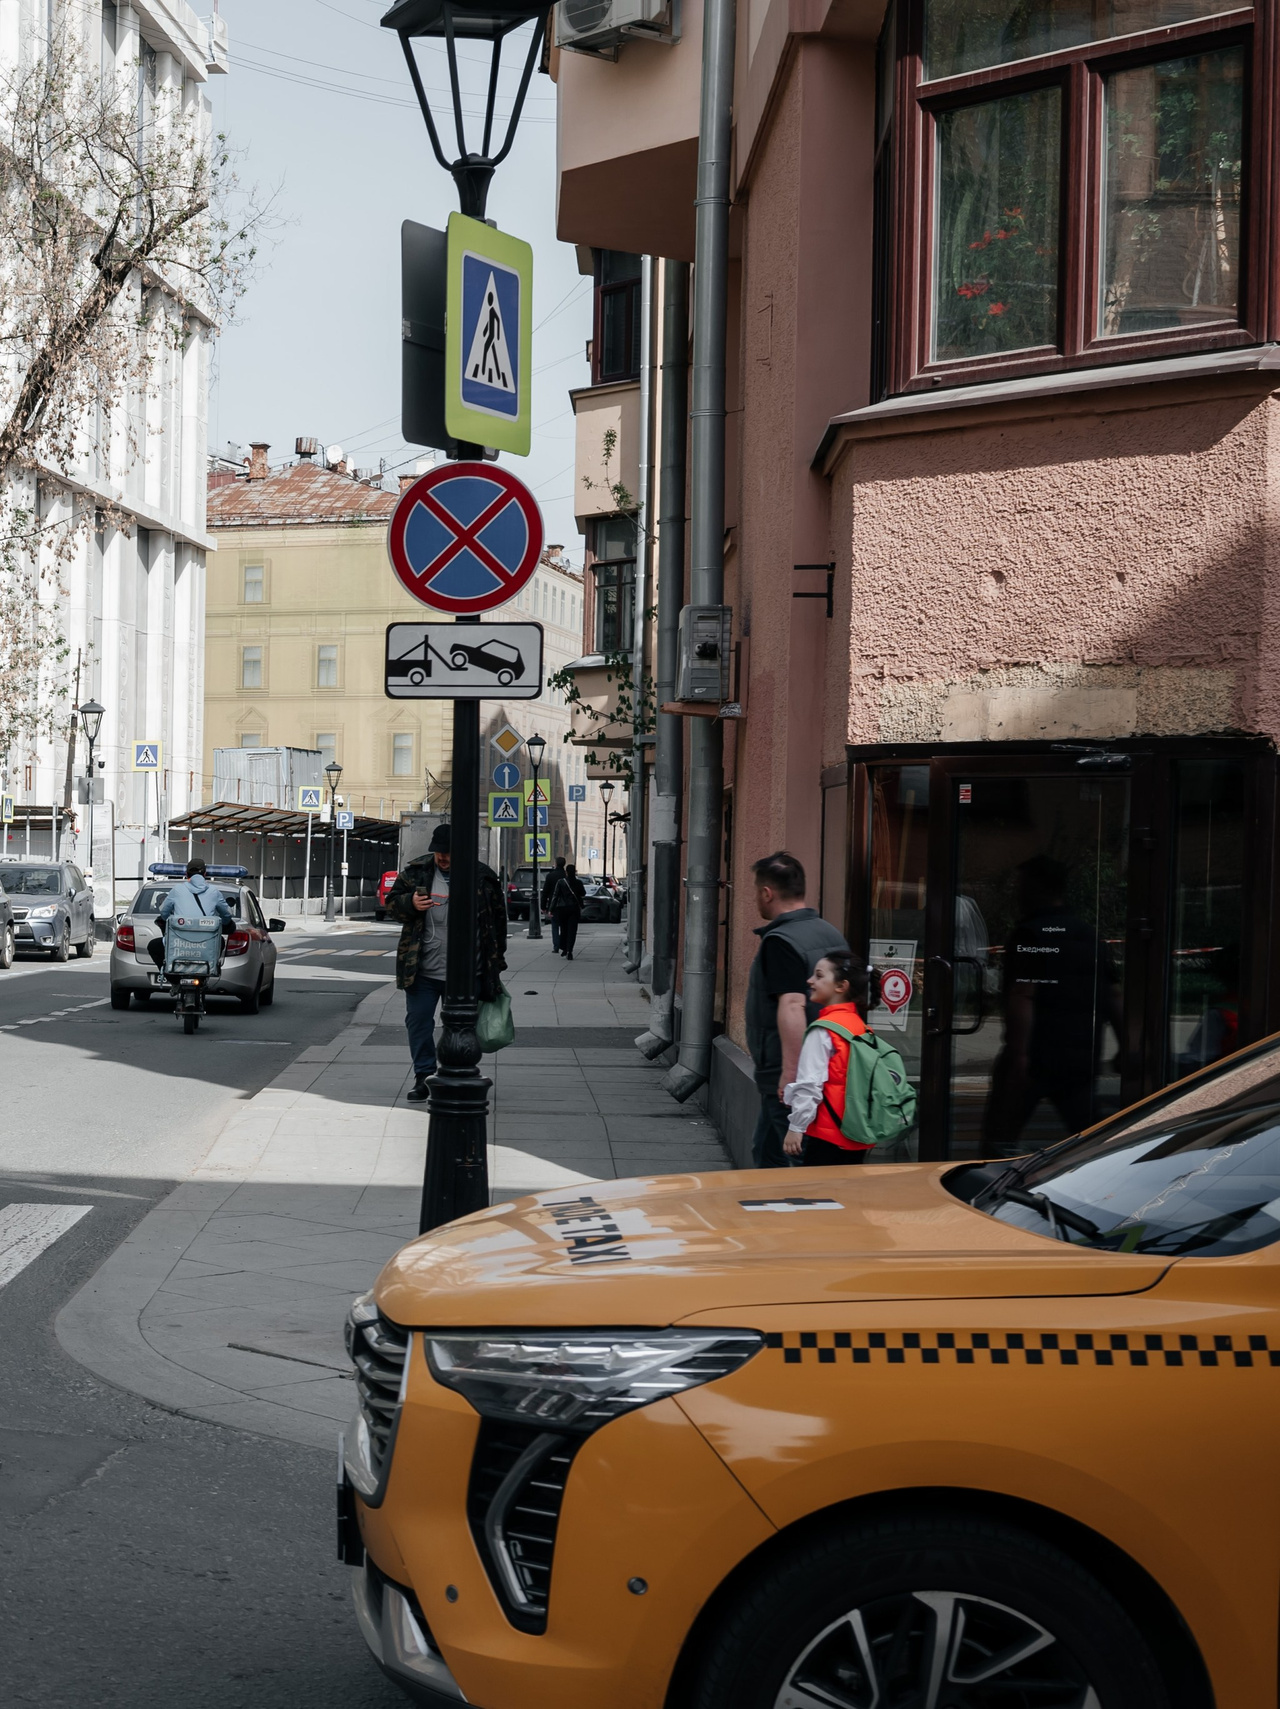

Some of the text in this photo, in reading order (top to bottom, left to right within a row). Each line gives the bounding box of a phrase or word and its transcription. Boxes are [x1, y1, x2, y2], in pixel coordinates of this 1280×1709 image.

[573, 787, 583, 800] P
[339, 813, 349, 827] P
[173, 938, 207, 949] Яндекс
[1016, 944, 1060, 954] Ежедневно
[172, 948, 202, 957] Лавка
[561, 1223, 632, 1266] TAXI
